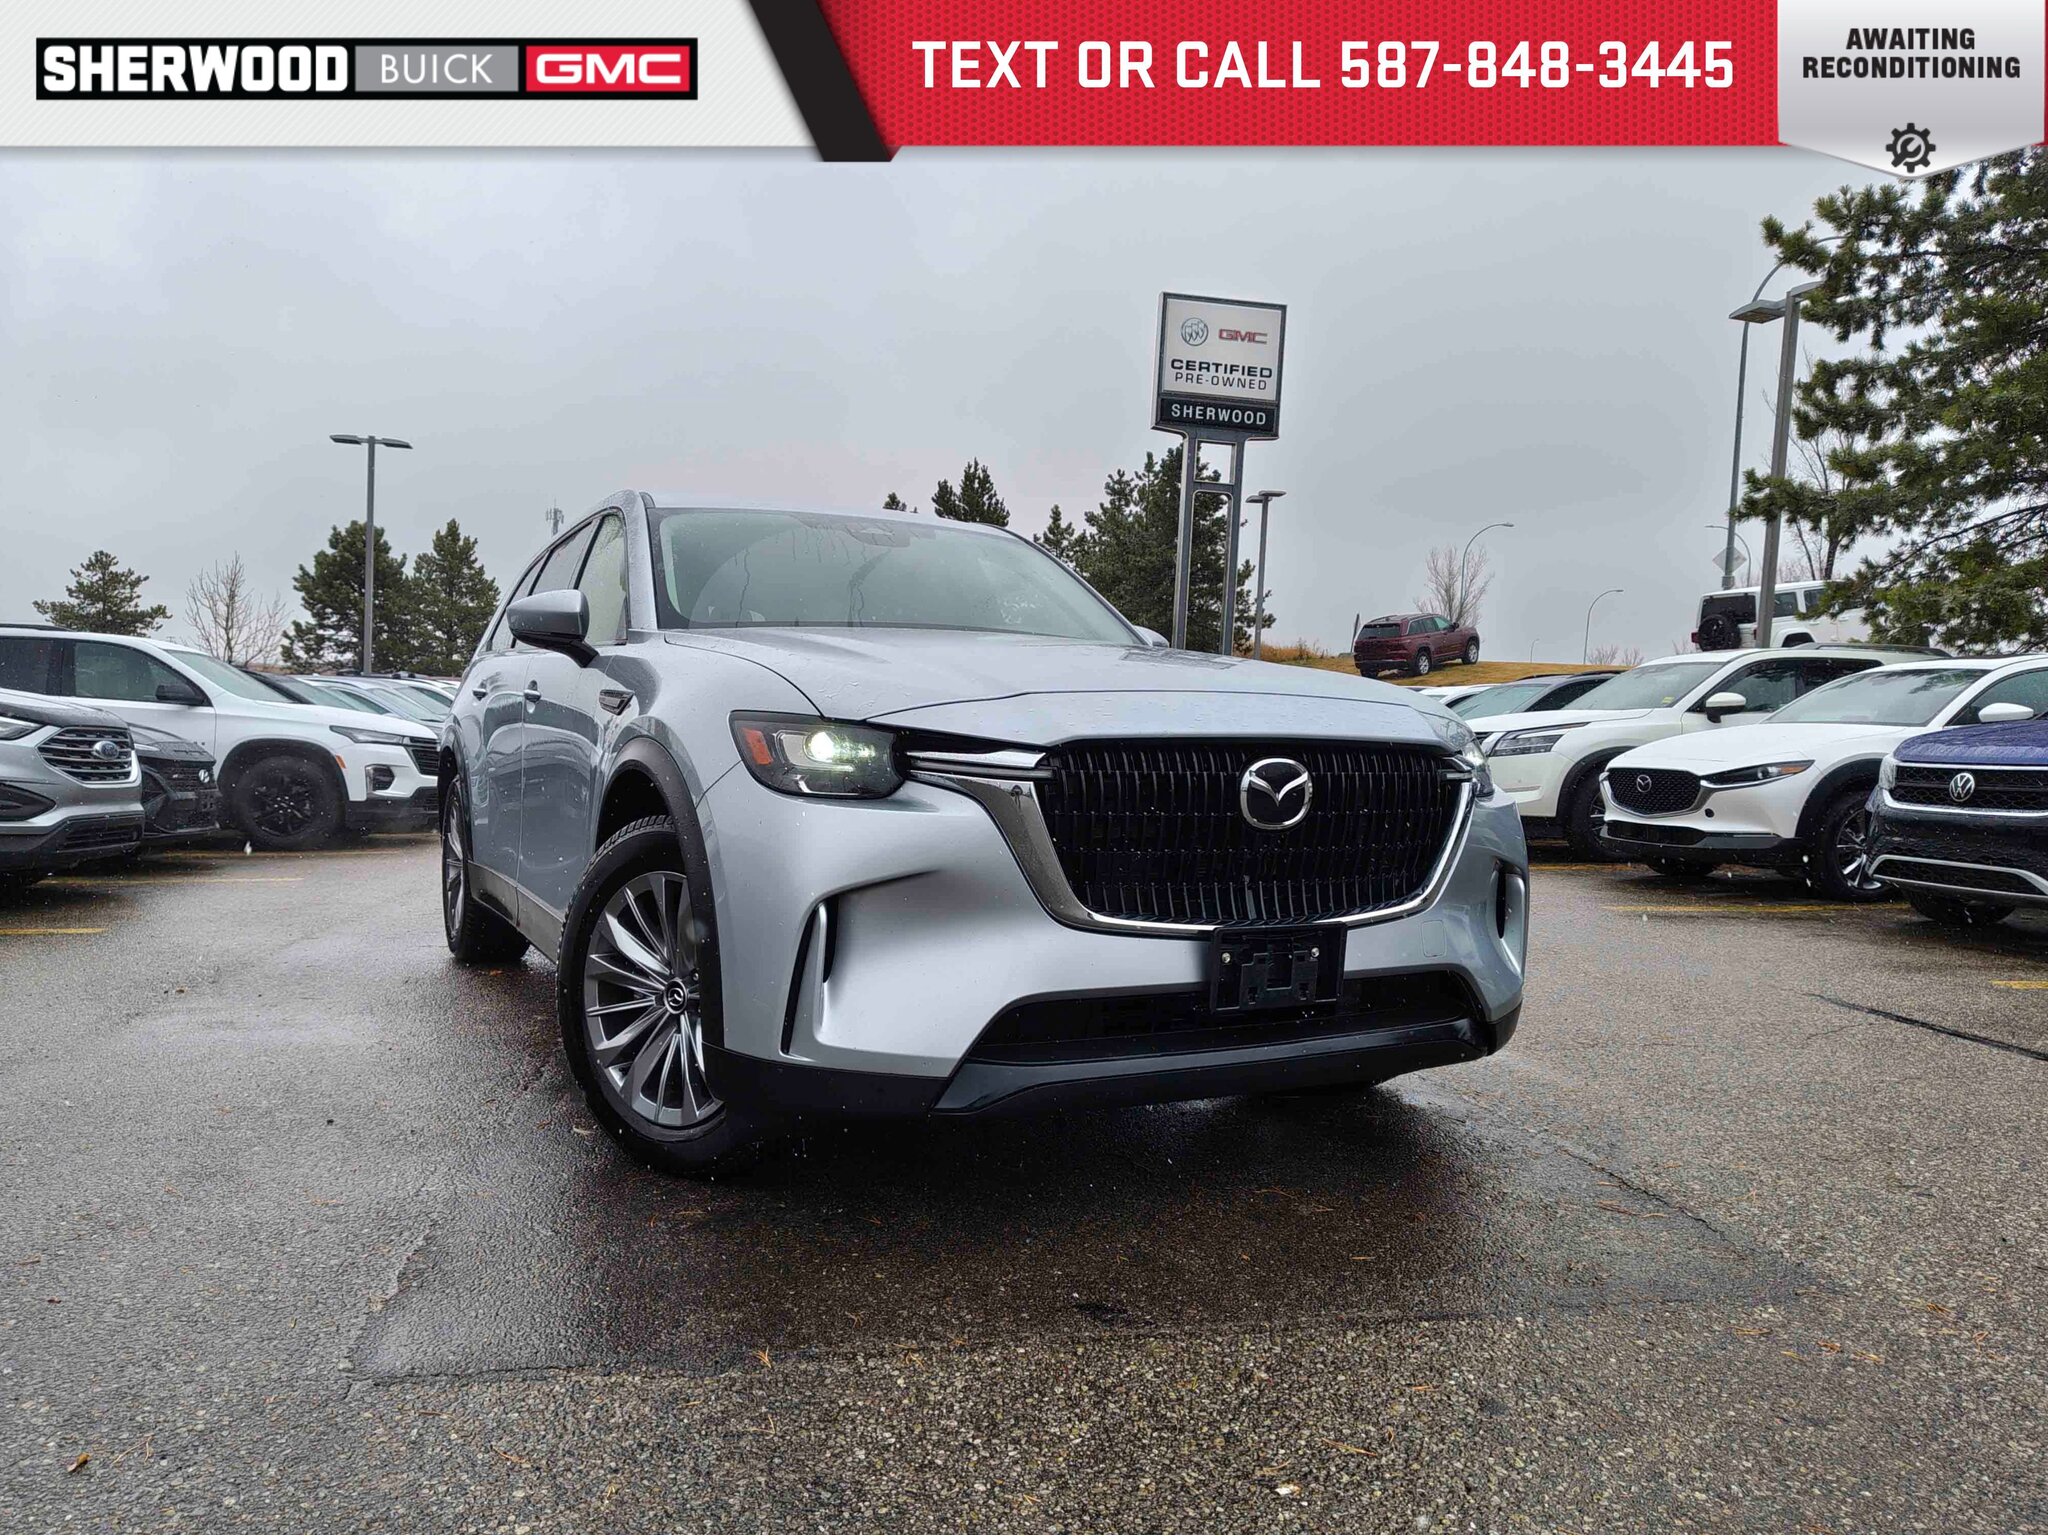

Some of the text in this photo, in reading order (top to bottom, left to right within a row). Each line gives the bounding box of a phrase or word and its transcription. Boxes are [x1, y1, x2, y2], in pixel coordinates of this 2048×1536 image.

[1218, 328, 1268, 345] GMC
[1170, 358, 1273, 379] CERTIFIED
[1175, 372, 1267, 391] PRE-OWNED
[1171, 403, 1267, 425] SHERWOOD
